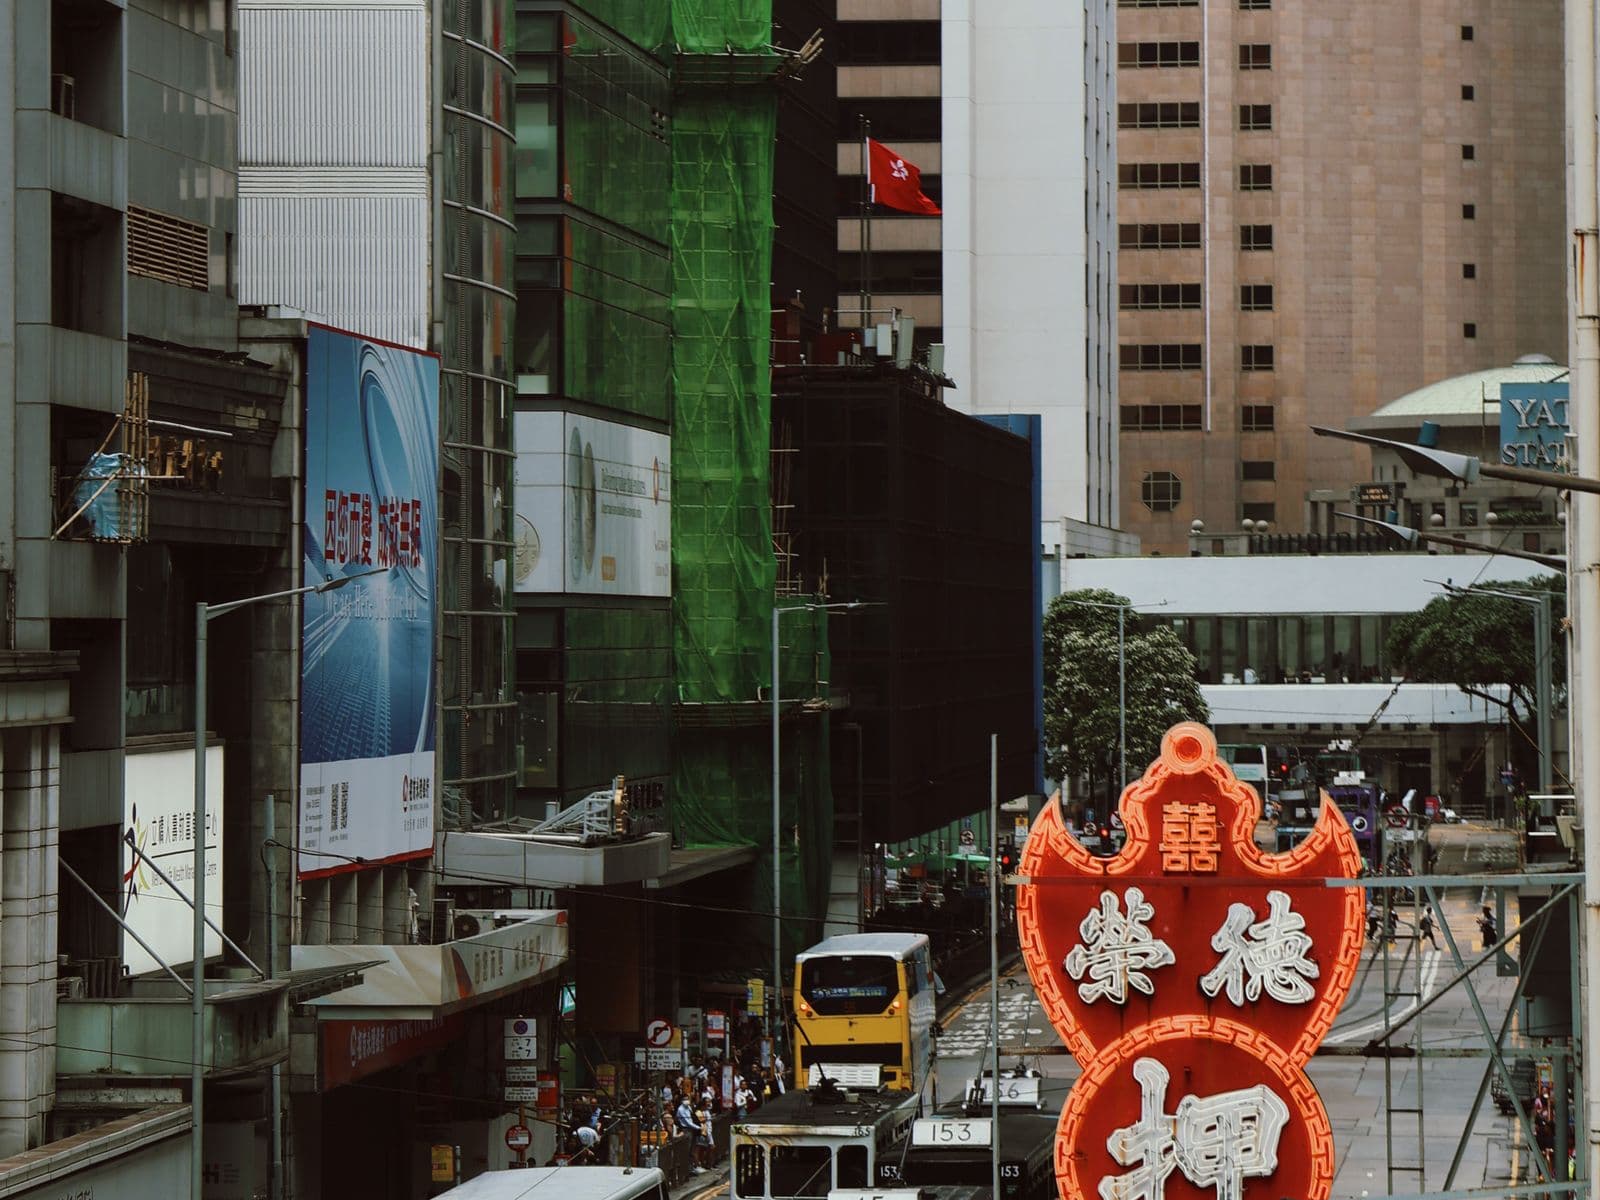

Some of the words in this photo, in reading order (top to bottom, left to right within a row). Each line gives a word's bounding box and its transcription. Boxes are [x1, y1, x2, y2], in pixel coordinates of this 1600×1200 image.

[324, 489, 372, 566] 因您而變
[932, 1123, 972, 1142] 153
[880, 1166, 898, 1178] 153
[1001, 1166, 1020, 1178] 153
